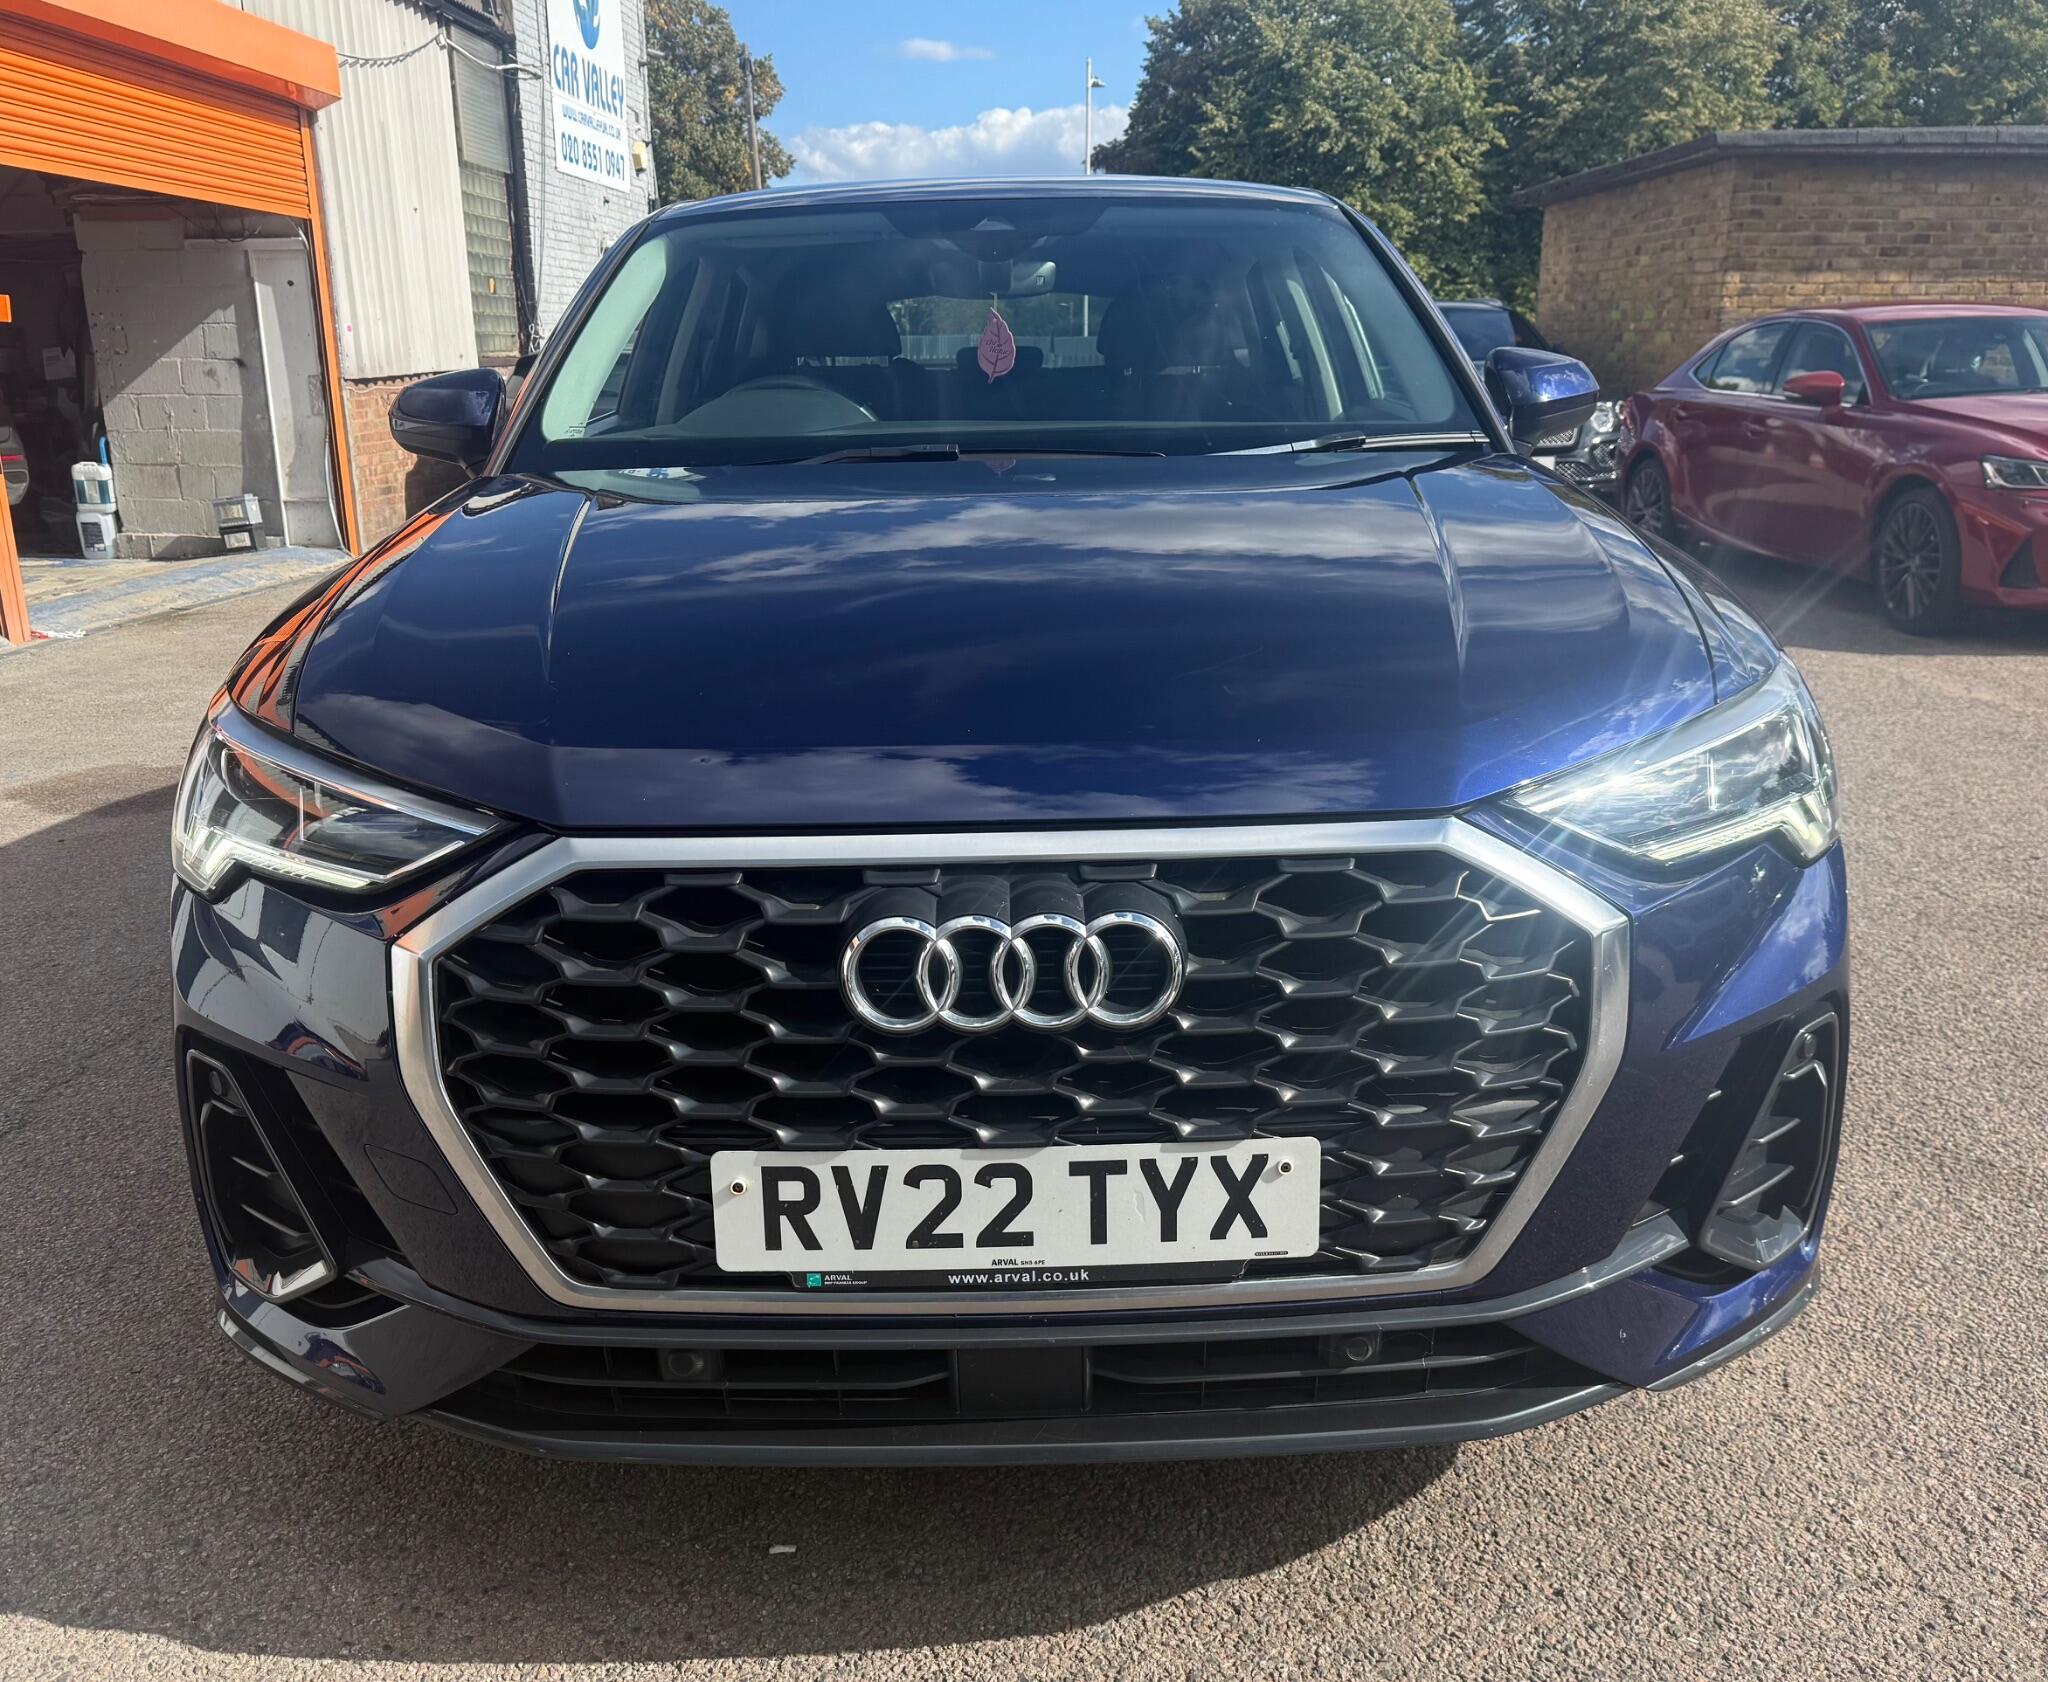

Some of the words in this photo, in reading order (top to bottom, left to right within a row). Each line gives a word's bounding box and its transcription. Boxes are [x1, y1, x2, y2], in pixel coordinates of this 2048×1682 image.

[553, 44, 579, 99] CAR
[581, 56, 624, 119] VALLEY
[561, 131, 579, 166] 020
[581, 139, 603, 174] 8551
[605, 149, 625, 181] 0947
[760, 1163, 1035, 1251] RV22
[1068, 1153, 1269, 1246] TYX
[948, 1269, 1089, 1284] www.arval.co.uk
[991, 1258, 1019, 1266] ARVAL
